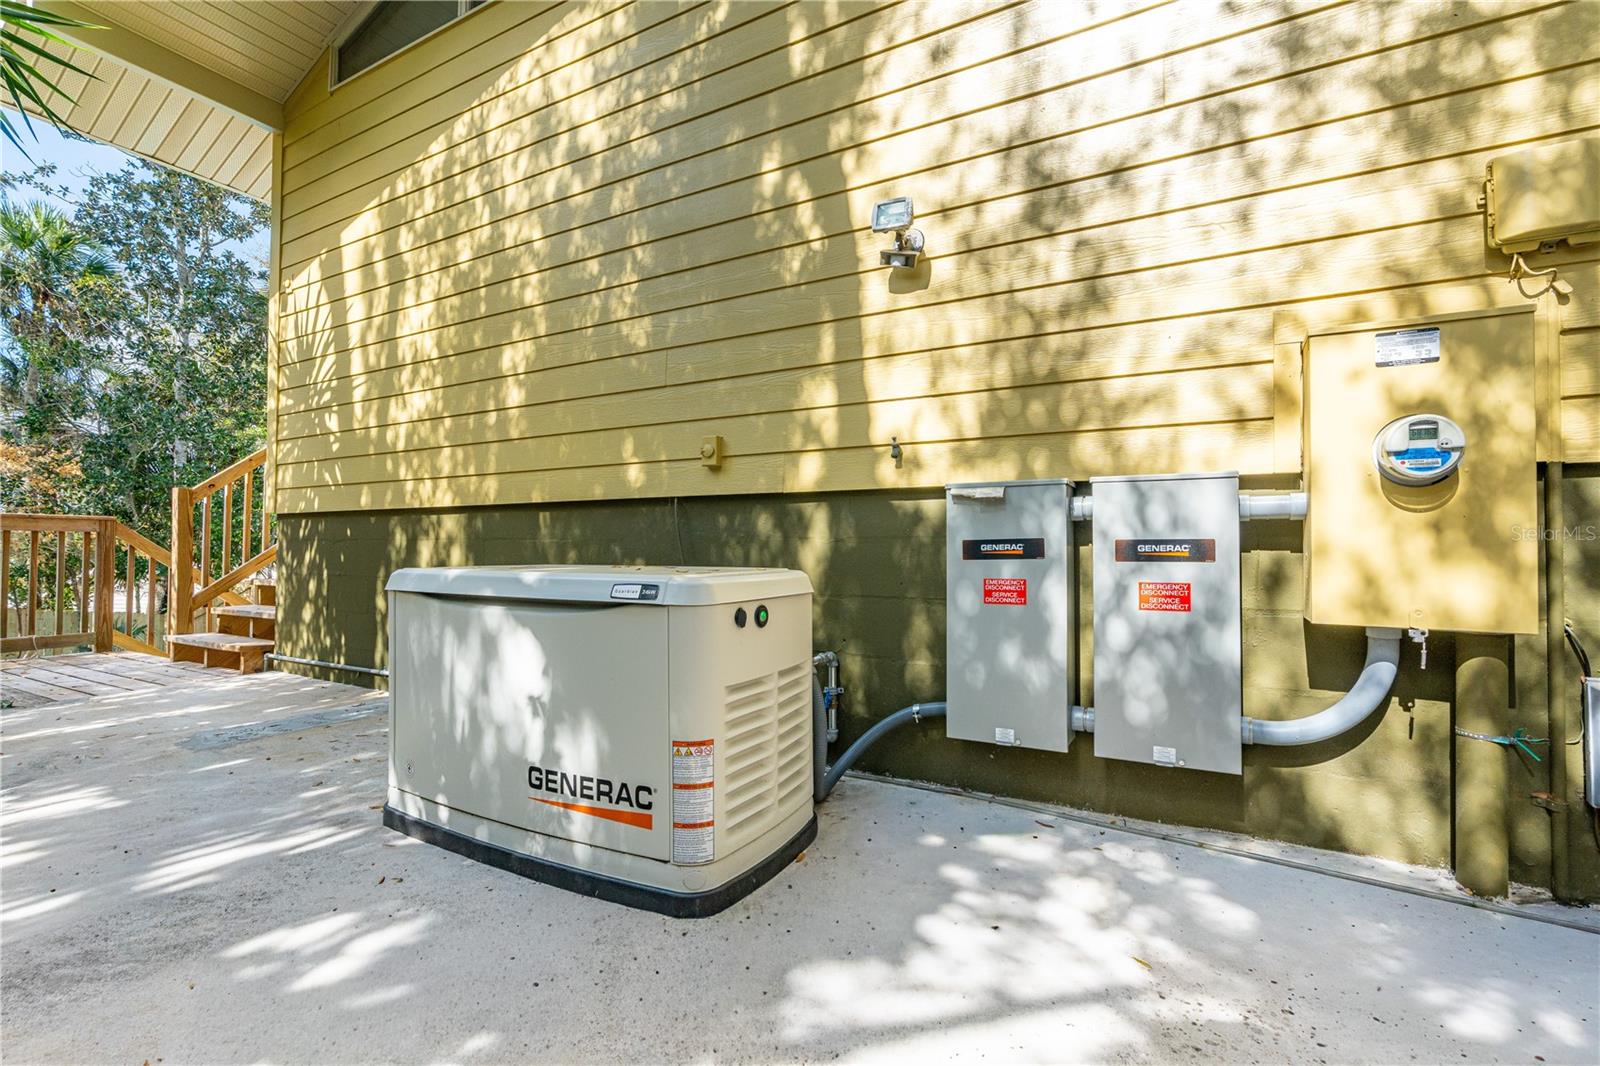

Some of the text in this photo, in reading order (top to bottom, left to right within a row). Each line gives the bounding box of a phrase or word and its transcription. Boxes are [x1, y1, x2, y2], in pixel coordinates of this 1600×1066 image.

[980, 543, 1024, 551] GENERAC
[1137, 544, 1190, 552] GENERAC
[527, 765, 653, 810] GENERAC
